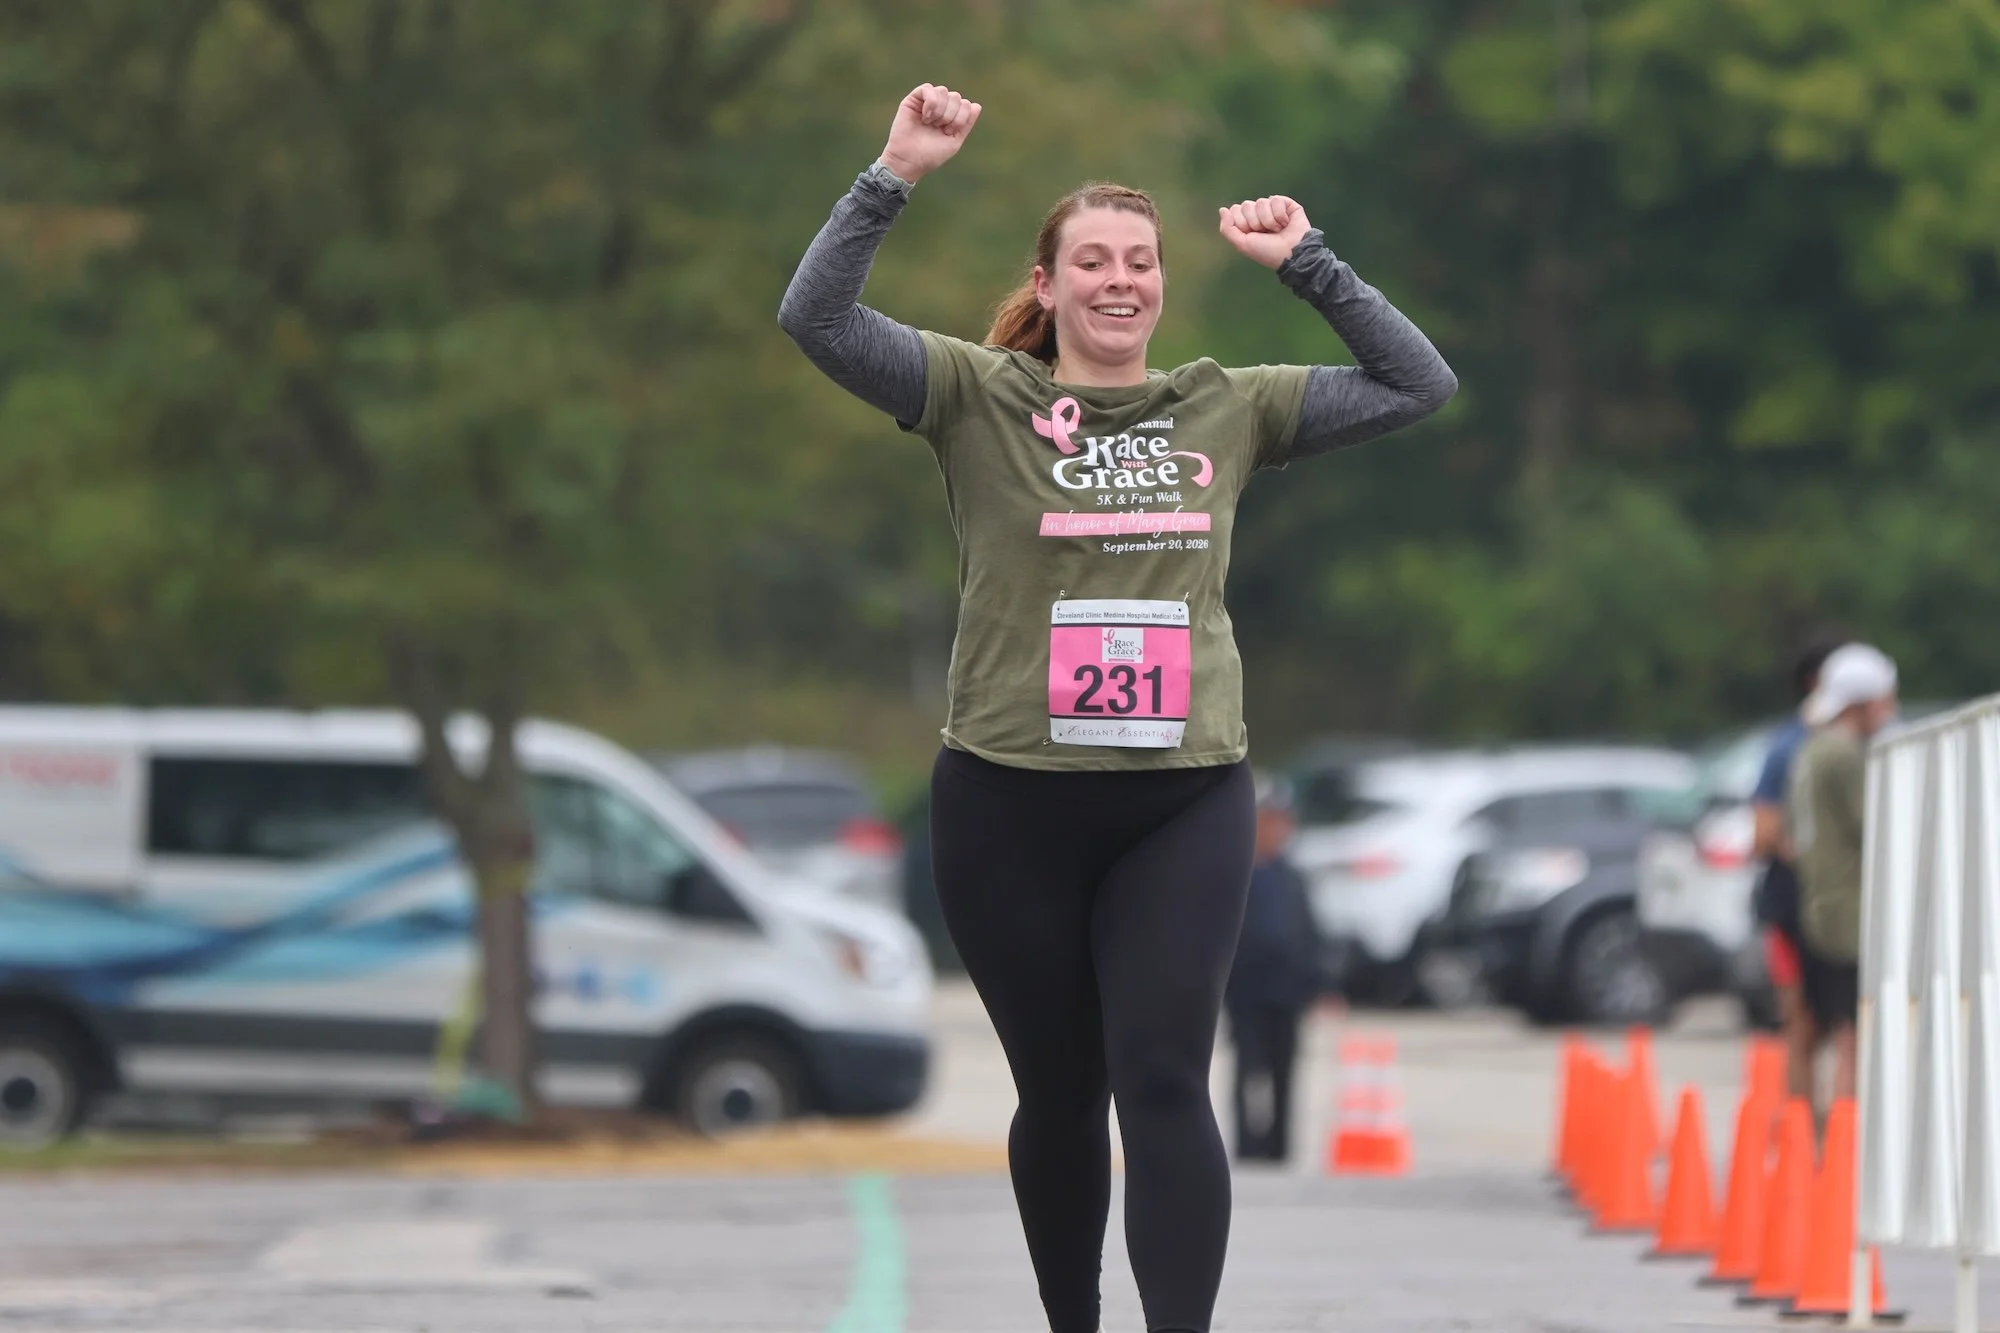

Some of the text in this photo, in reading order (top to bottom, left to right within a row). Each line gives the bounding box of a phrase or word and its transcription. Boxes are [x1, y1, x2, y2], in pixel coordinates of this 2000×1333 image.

[1083, 433, 1170, 469] Race
[1121, 460, 1148, 469] With
[1052, 456, 1180, 490] Grace
[1096, 491, 1183, 506] 5K & Fun Walk
[1065, 509, 1105, 533] honor
[1109, 511, 1124, 537] of
[1127, 507, 1169, 539] Mary
[1172, 504, 1209, 535] Grace
[1102, 538, 1209, 555] September 20, 2026
[1126, 612, 1151, 620] Hospital
[1107, 645, 1136, 656] Grace
[1114, 639, 1135, 649] Race
[1073, 664, 1163, 715] 231
[1067, 725, 1114, 737] ELEGANT
